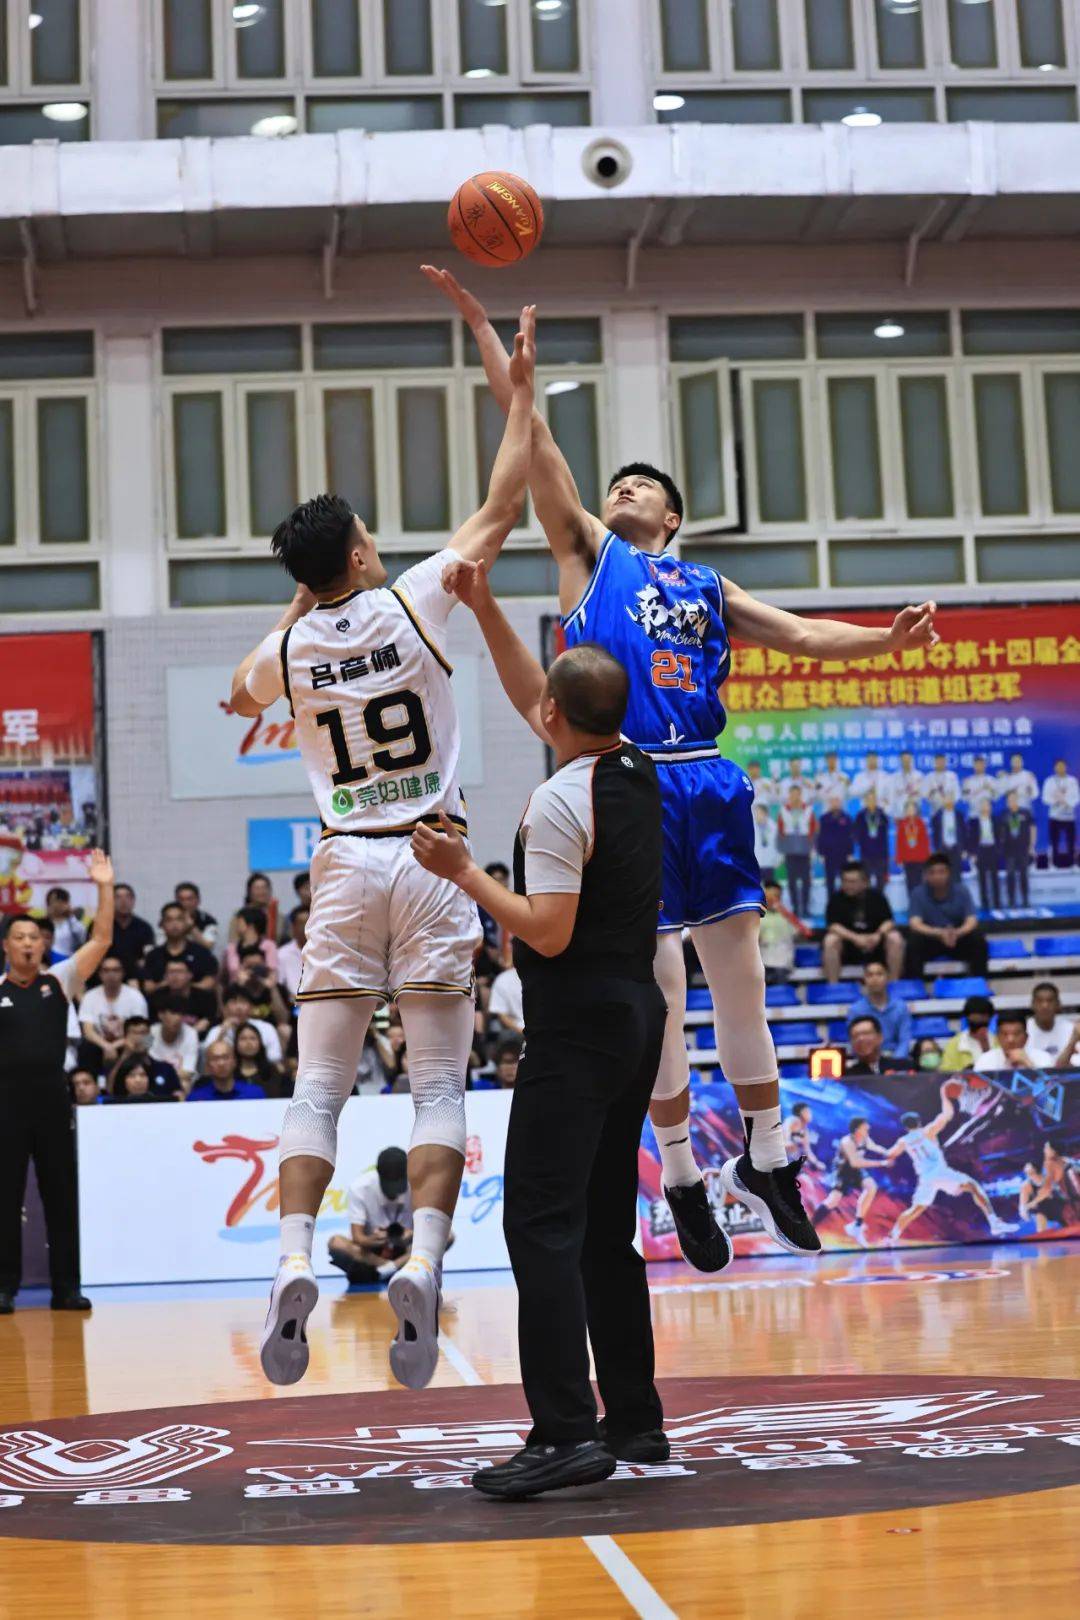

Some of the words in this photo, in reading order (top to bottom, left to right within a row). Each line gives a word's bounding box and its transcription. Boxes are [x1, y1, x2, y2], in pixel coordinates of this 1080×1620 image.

[310, 643, 401, 690] 吕彦佩
[650, 650, 697, 692] 21
[316, 689, 433, 784] 19
[356, 772, 441, 808] 莞好健康
